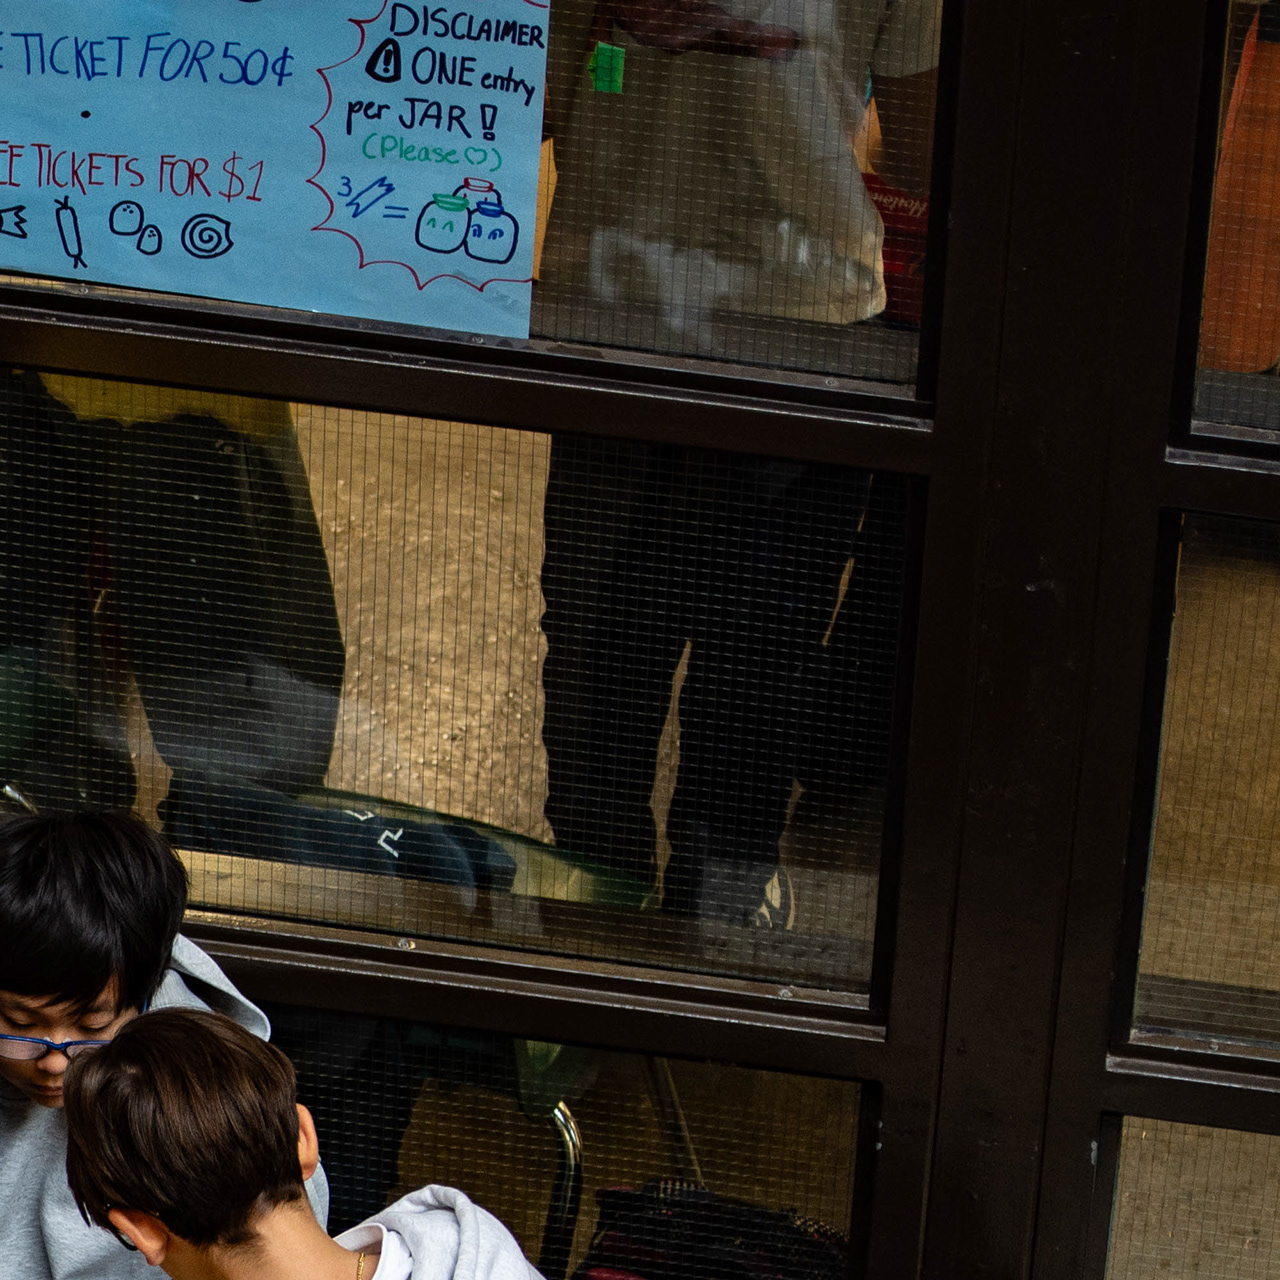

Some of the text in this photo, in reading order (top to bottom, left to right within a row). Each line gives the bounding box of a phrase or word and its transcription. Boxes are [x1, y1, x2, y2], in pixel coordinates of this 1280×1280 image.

[389, 3, 545, 49] DISCLAIMER
[10, 32, 131, 81] TICKET
[138, 31, 208, 83] FOR
[219, 41, 295, 86] 50¢
[411, 46, 536, 107] ONE entry
[346, 100, 391, 136] per
[398, 97, 472, 139] JAR
[30, 143, 145, 196] TICKETS
[159, 154, 212, 198] FOR
[218, 150, 264, 203] $1
